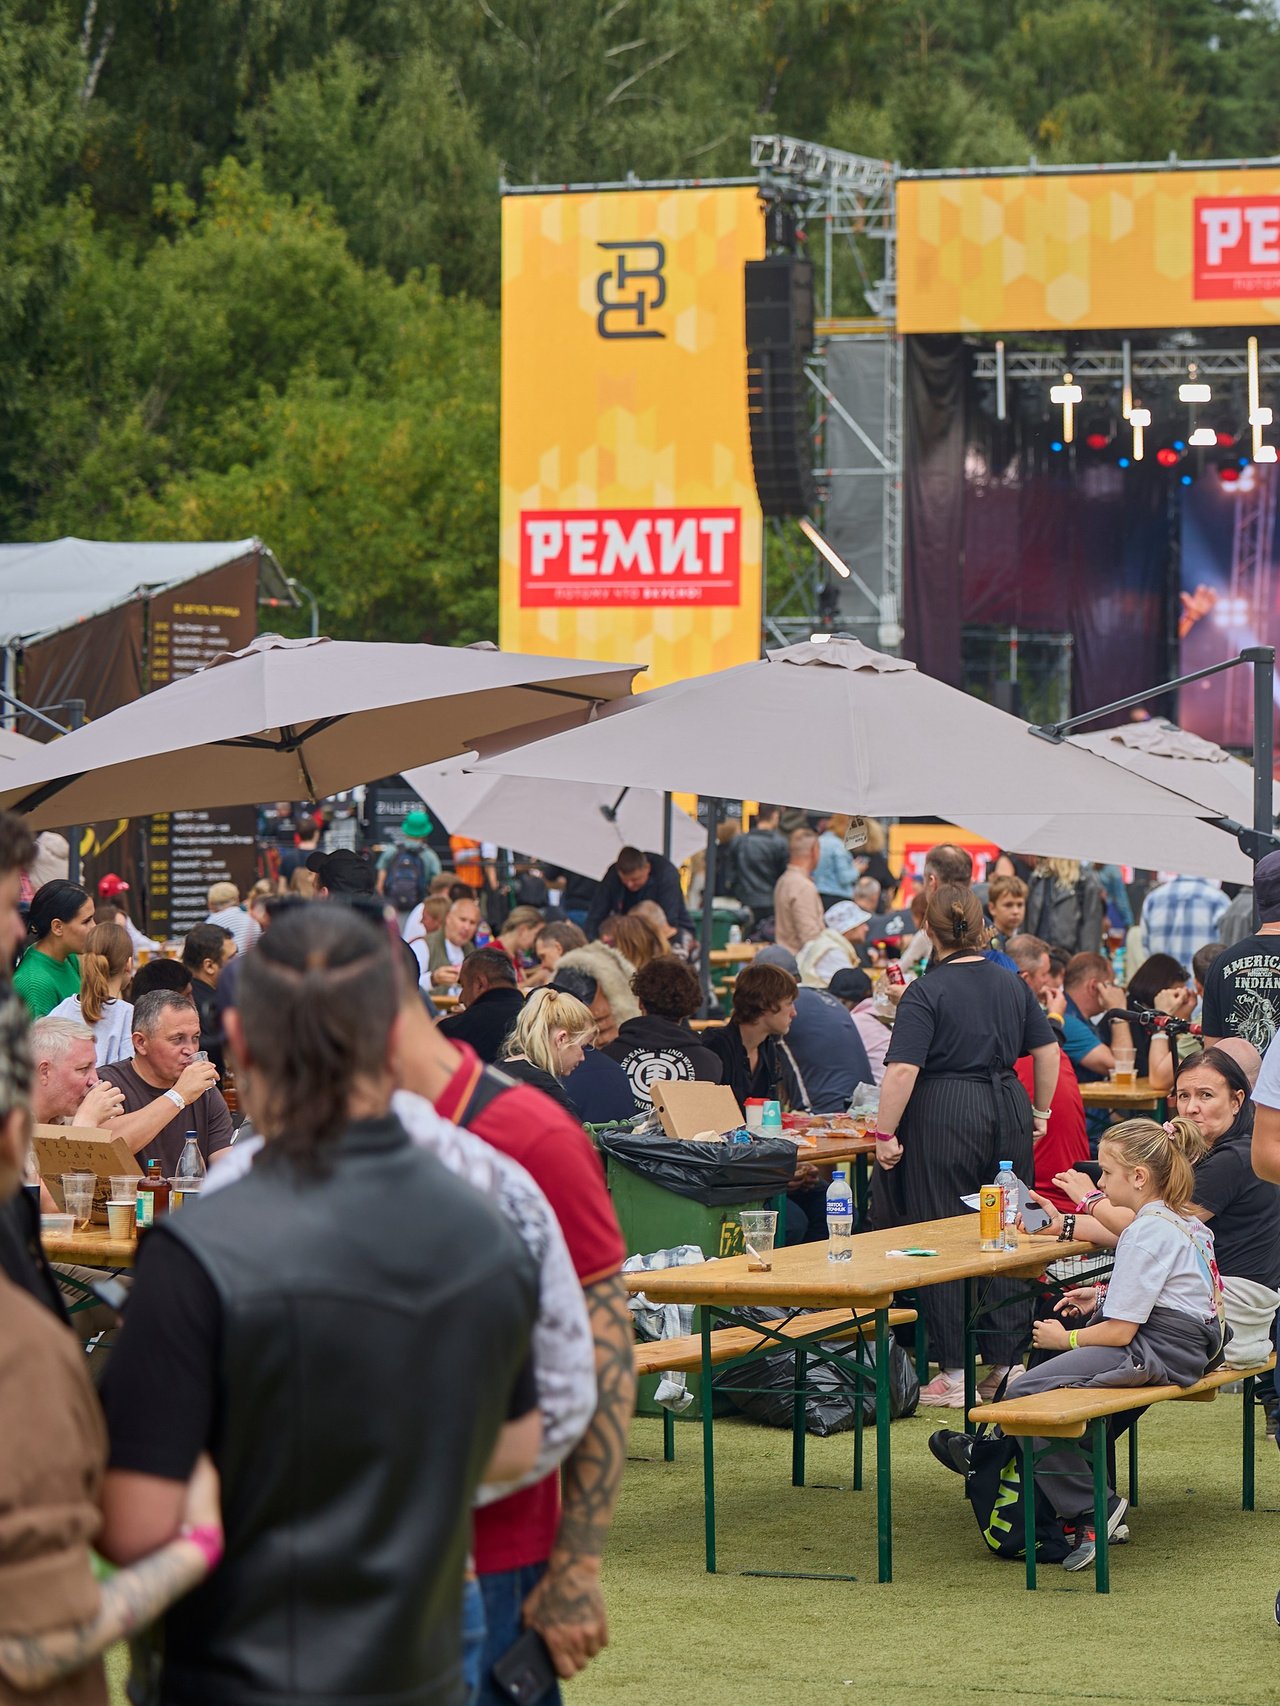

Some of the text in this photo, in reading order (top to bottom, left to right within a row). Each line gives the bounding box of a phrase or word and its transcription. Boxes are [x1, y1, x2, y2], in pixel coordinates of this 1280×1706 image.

[525, 518, 736, 576] РЕМИТ
[39, 1140, 94, 1151] PIZZA
[37, 1149, 108, 1161] NAPOLI
